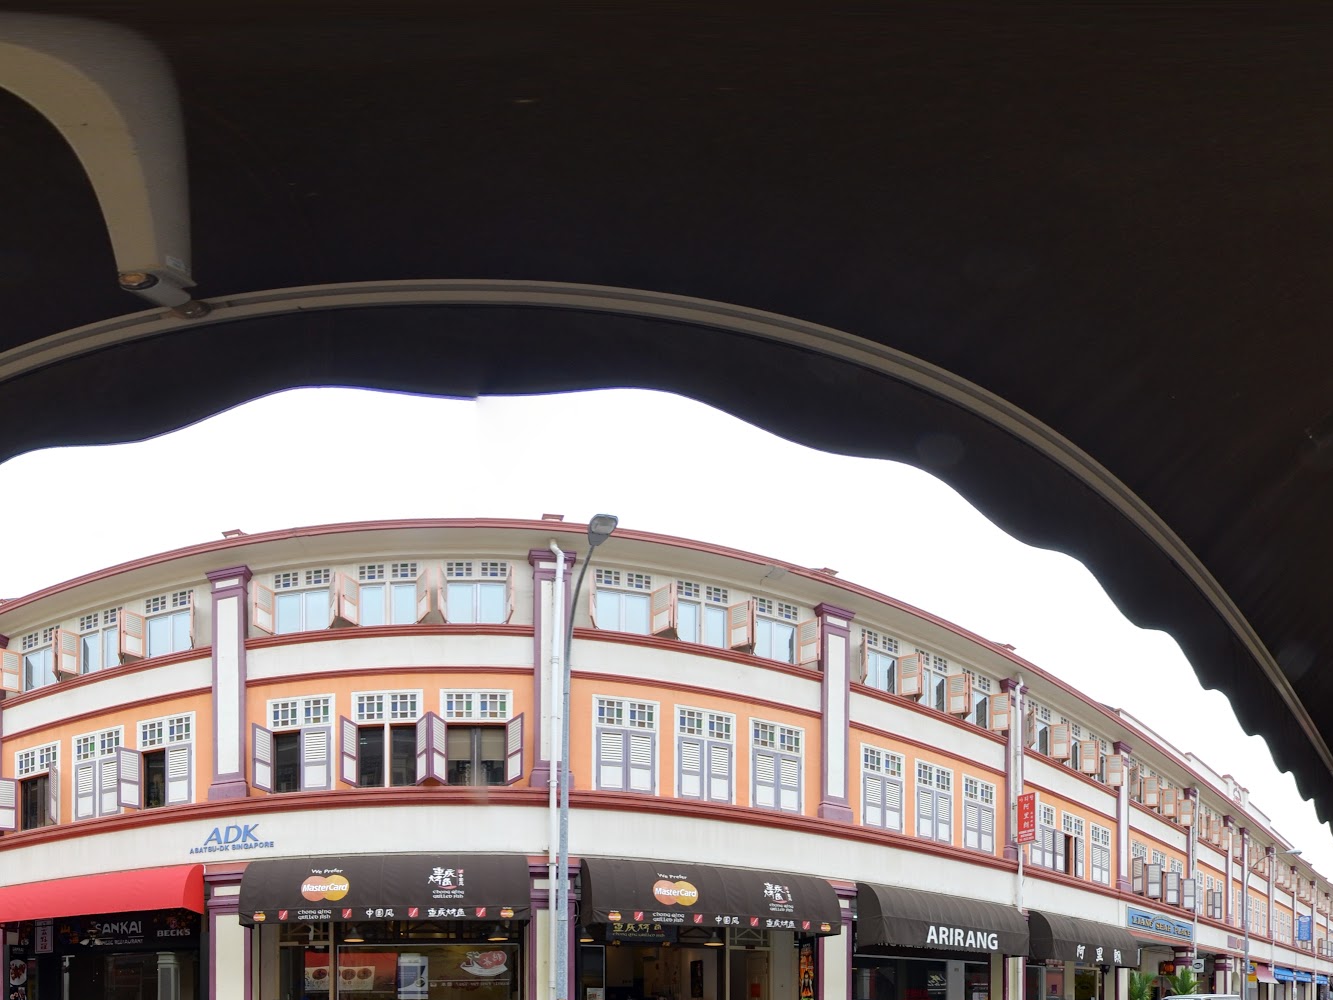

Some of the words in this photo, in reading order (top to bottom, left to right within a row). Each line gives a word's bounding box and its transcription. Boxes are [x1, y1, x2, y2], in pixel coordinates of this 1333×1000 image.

[203, 823, 259, 846] ADK
[231, 841, 275, 851] SINGAPORE
[302, 883, 348, 893] MasterCard
[655, 887, 697, 898] MasterCard
[95, 920, 142, 935] SANKAI
[156, 928, 191, 937] BECK'S
[1132, 915, 1153, 928] LIANG
[1155, 922, 1171, 932] SEAH
[1173, 926, 1191, 937] PLACE
[926, 925, 999, 950] ARIRANG
[1076, 944, 1122, 965] 阿里朗
